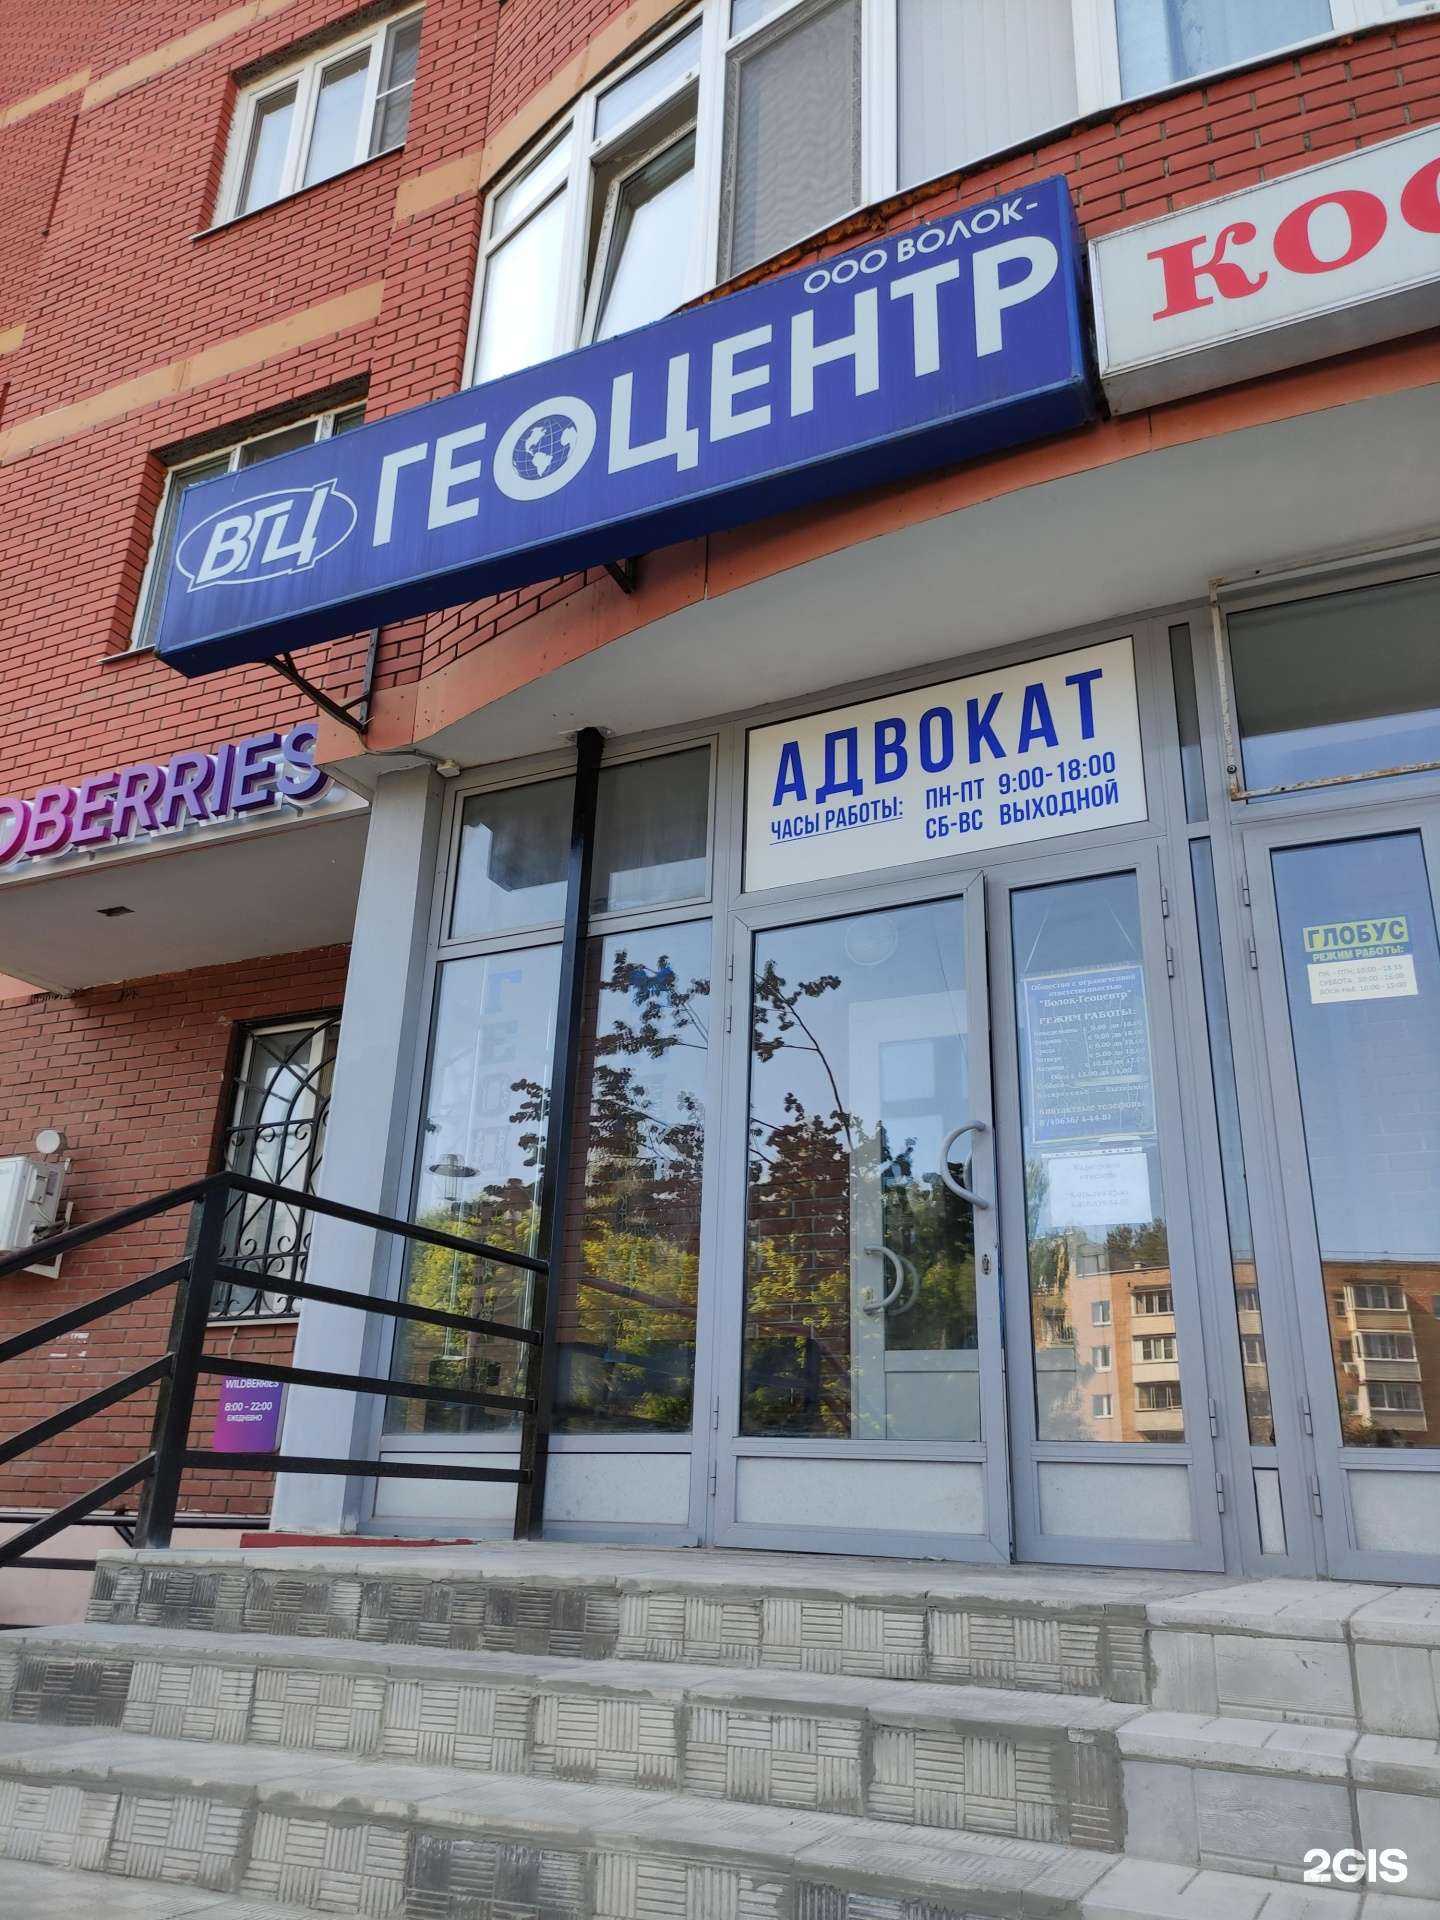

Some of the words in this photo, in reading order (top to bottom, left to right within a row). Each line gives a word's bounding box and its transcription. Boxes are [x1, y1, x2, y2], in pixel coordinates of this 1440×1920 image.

[803, 249, 888, 295] ООО
[897, 199, 1039, 257] ВОЛОК-
[372, 236, 1060, 547] ГЕОЦЕНТР
[196, 487, 329, 584] ВГЦ
[772, 668, 1103, 806] АДВОКАТ
[925, 778, 984, 810] ПН-ПТ
[998, 751, 1116, 795] 9:00-18:00
[925, 809, 983, 840] СБ-ВС
[1000, 778, 1119, 826] ВЫХОДНОЙ
[771, 809, 821, 840] ЧАСЫ
[825, 798, 904, 834] РАБОТЫ:
[1307, 920, 1405, 949] ГЛОБУС
[1313, 950, 1353, 962] РЕЖИМ
[224, 1402, 243, 1411] 8:00
[250, 1401, 272, 1411] 22:00
